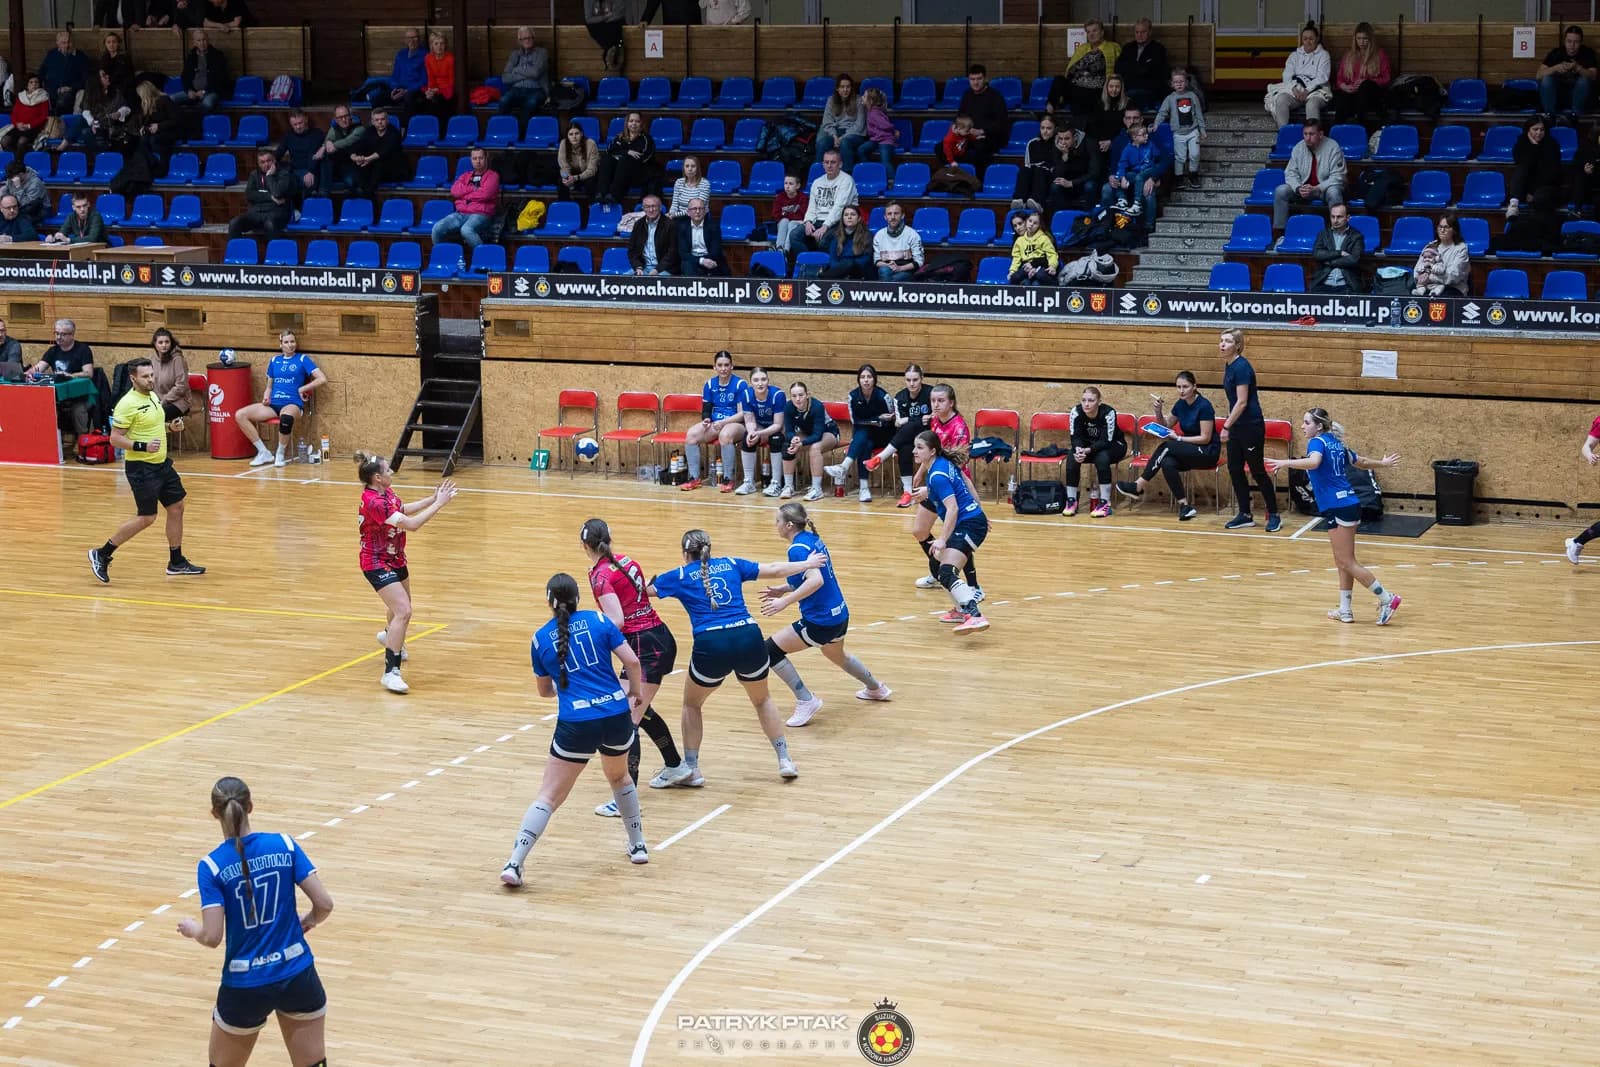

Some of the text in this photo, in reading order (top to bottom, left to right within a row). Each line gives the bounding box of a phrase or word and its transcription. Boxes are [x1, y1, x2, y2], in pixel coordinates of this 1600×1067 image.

[650, 41, 658, 52] A
[1520, 40, 1528, 51] B
[0, 263, 116, 284] oronahandball.pl
[199, 268, 376, 292] www.koronahandball.pl
[556, 279, 750, 303] www.koronahandball.pl
[850, 287, 1060, 312] www.koronahandball.pl
[1168, 296, 1390, 323] www.koronahandball.p
[1513, 305, 1600, 324] www.kor
[708, 576, 732, 605] 3
[552, 630, 599, 673] 11
[235, 870, 281, 930] 17
